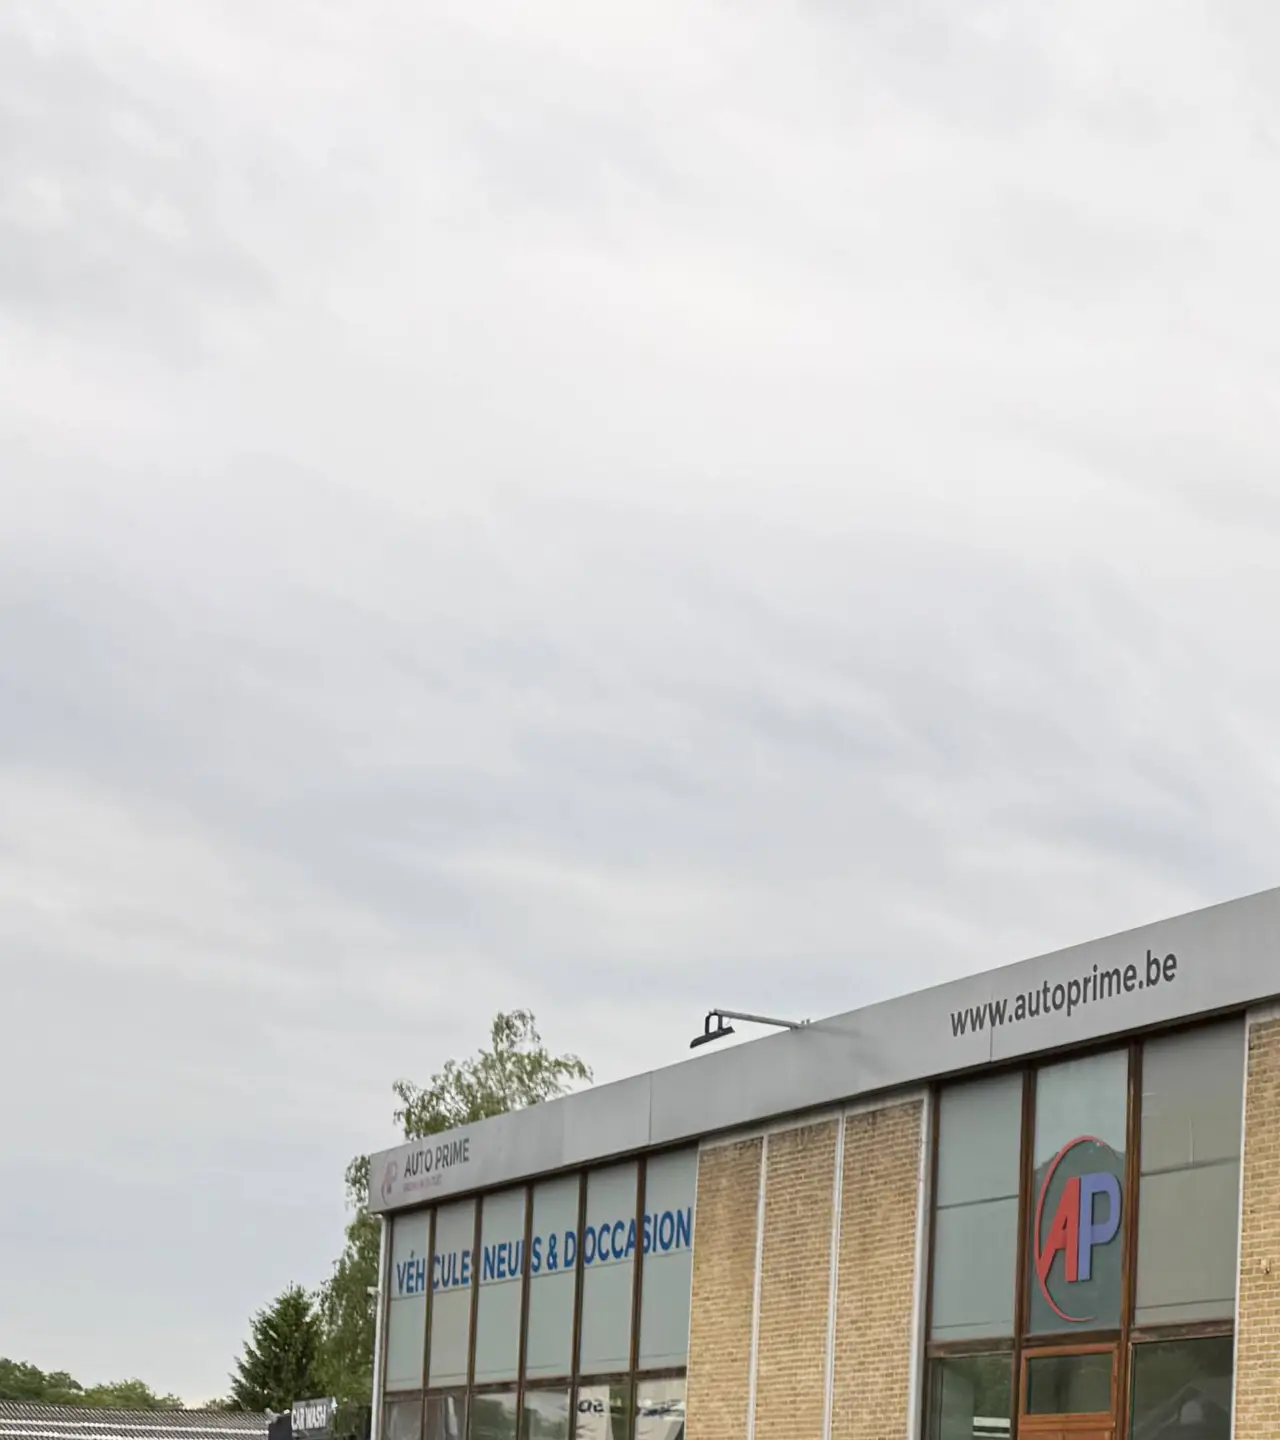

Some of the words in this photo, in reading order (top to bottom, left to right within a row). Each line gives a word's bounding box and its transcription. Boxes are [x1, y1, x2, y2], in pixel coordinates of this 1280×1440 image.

[950, 949, 1178, 1038] www.autoprime.be
[403, 1148, 433, 1178] AUTO
[435, 1138, 470, 1171] PRIME
[396, 1248, 475, 1295] VÉHCULE
[483, 1235, 542, 1282] NEUS
[546, 1232, 558, 1271] &
[1037, 1172, 1123, 1284] AP
